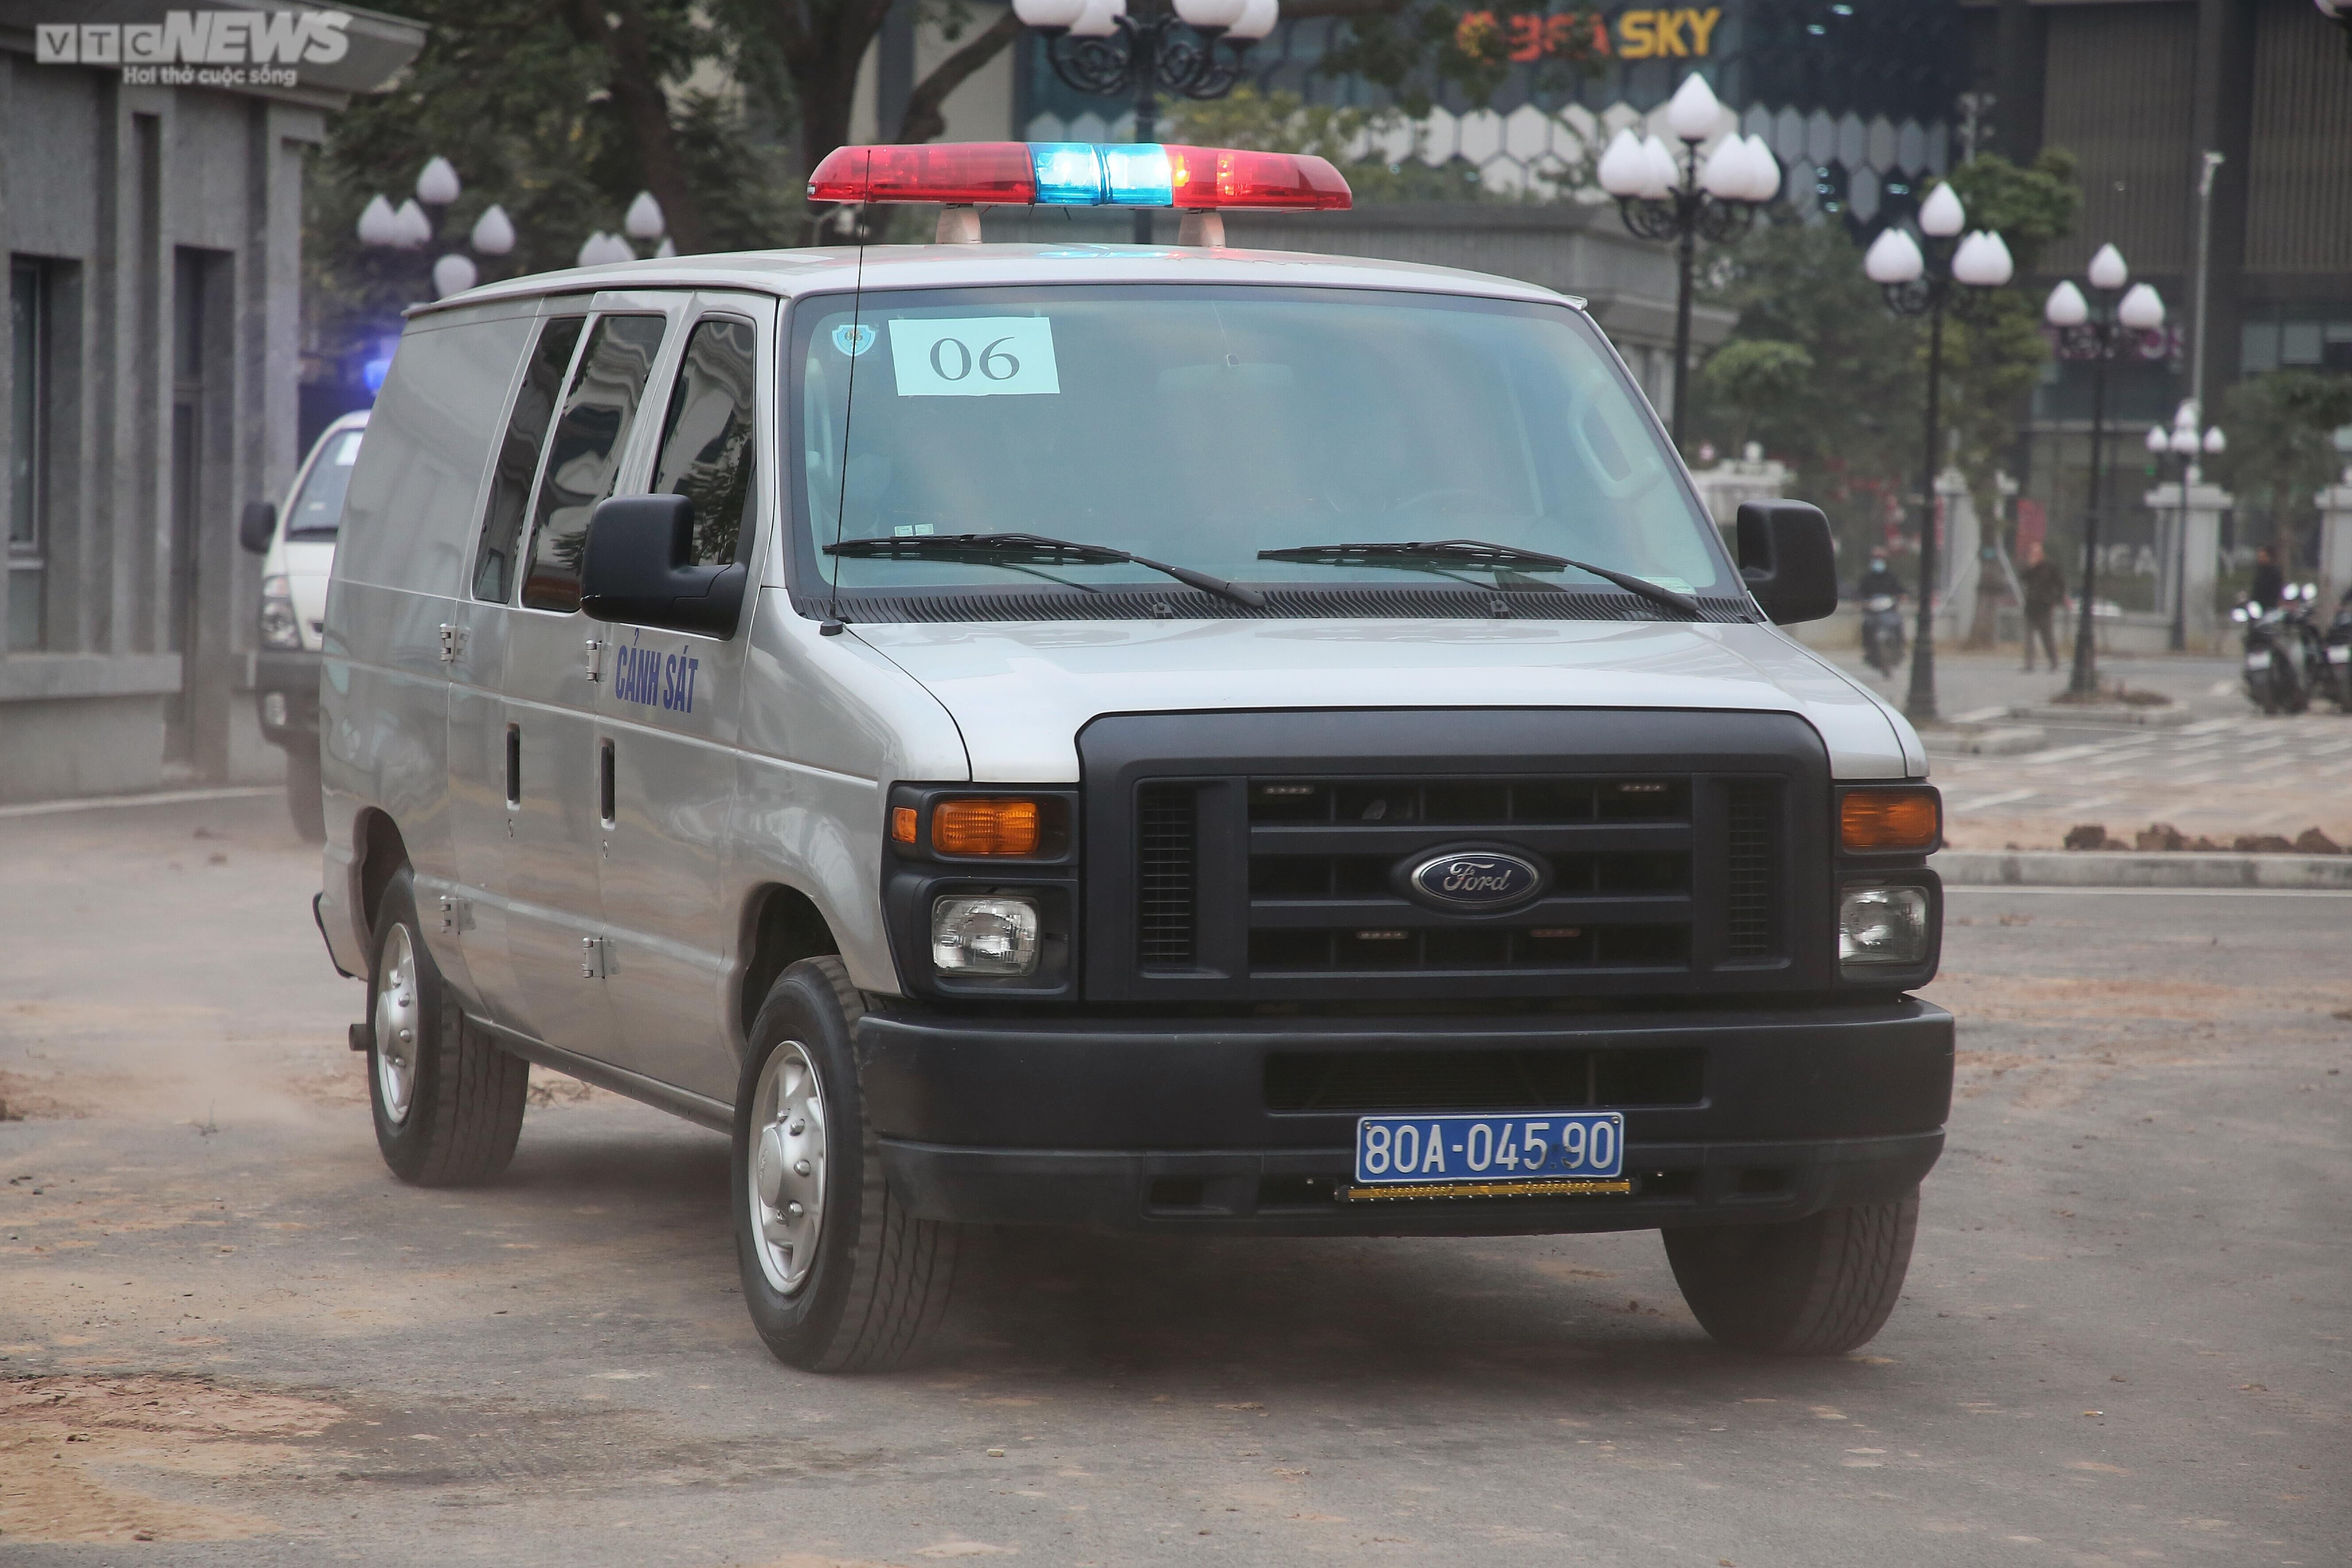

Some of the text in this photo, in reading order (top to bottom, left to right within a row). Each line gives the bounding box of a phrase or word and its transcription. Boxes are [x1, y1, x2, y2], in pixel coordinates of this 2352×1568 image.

[1619, 8, 1720, 59] SKY
[929, 336, 1020, 381] 06
[615, 628, 699, 713] CẢNH SÁT
[1443, 862, 1512, 891] Ford
